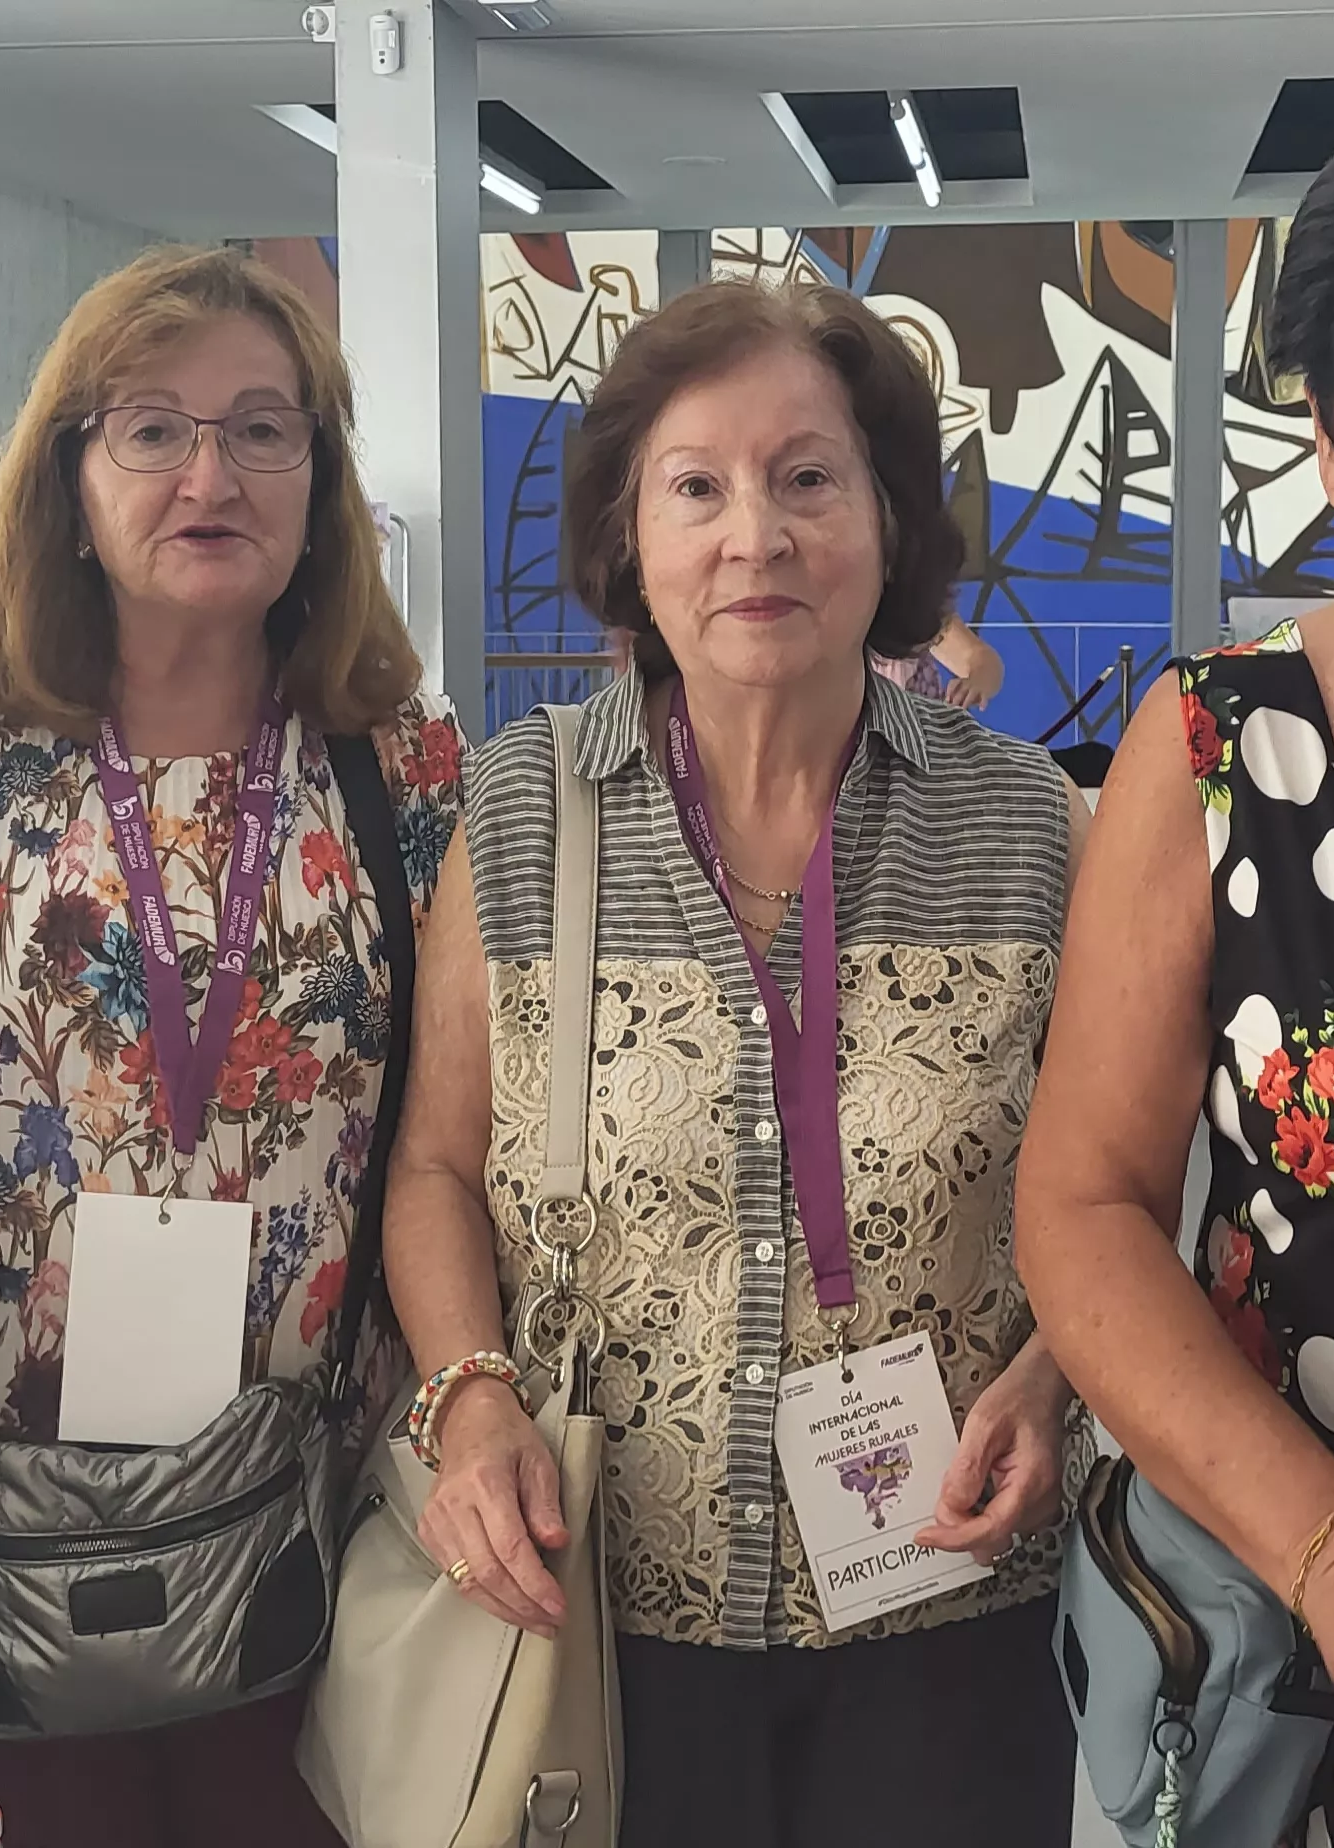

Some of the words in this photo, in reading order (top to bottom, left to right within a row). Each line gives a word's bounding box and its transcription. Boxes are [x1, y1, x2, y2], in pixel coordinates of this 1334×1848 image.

[670, 728, 689, 779] FADEMUR
[119, 823, 129, 836] DE
[123, 836, 139, 870] HUESCA
[240, 826, 261, 875] FADEMUR
[142, 894, 166, 950] FADEMUR
[240, 898, 252, 930] HUESCA
[237, 930, 247, 946] DE
[808, 1394, 904, 1436] INTERNACIONAL
[840, 1390, 863, 1407] DÍA
[814, 1441, 867, 1468] MUJERES
[868, 1423, 919, 1448] RURALES
[840, 1428, 857, 1442] DE
[859, 1419, 881, 1437] LAS
[827, 1543, 936, 1591] PARTICIPA
